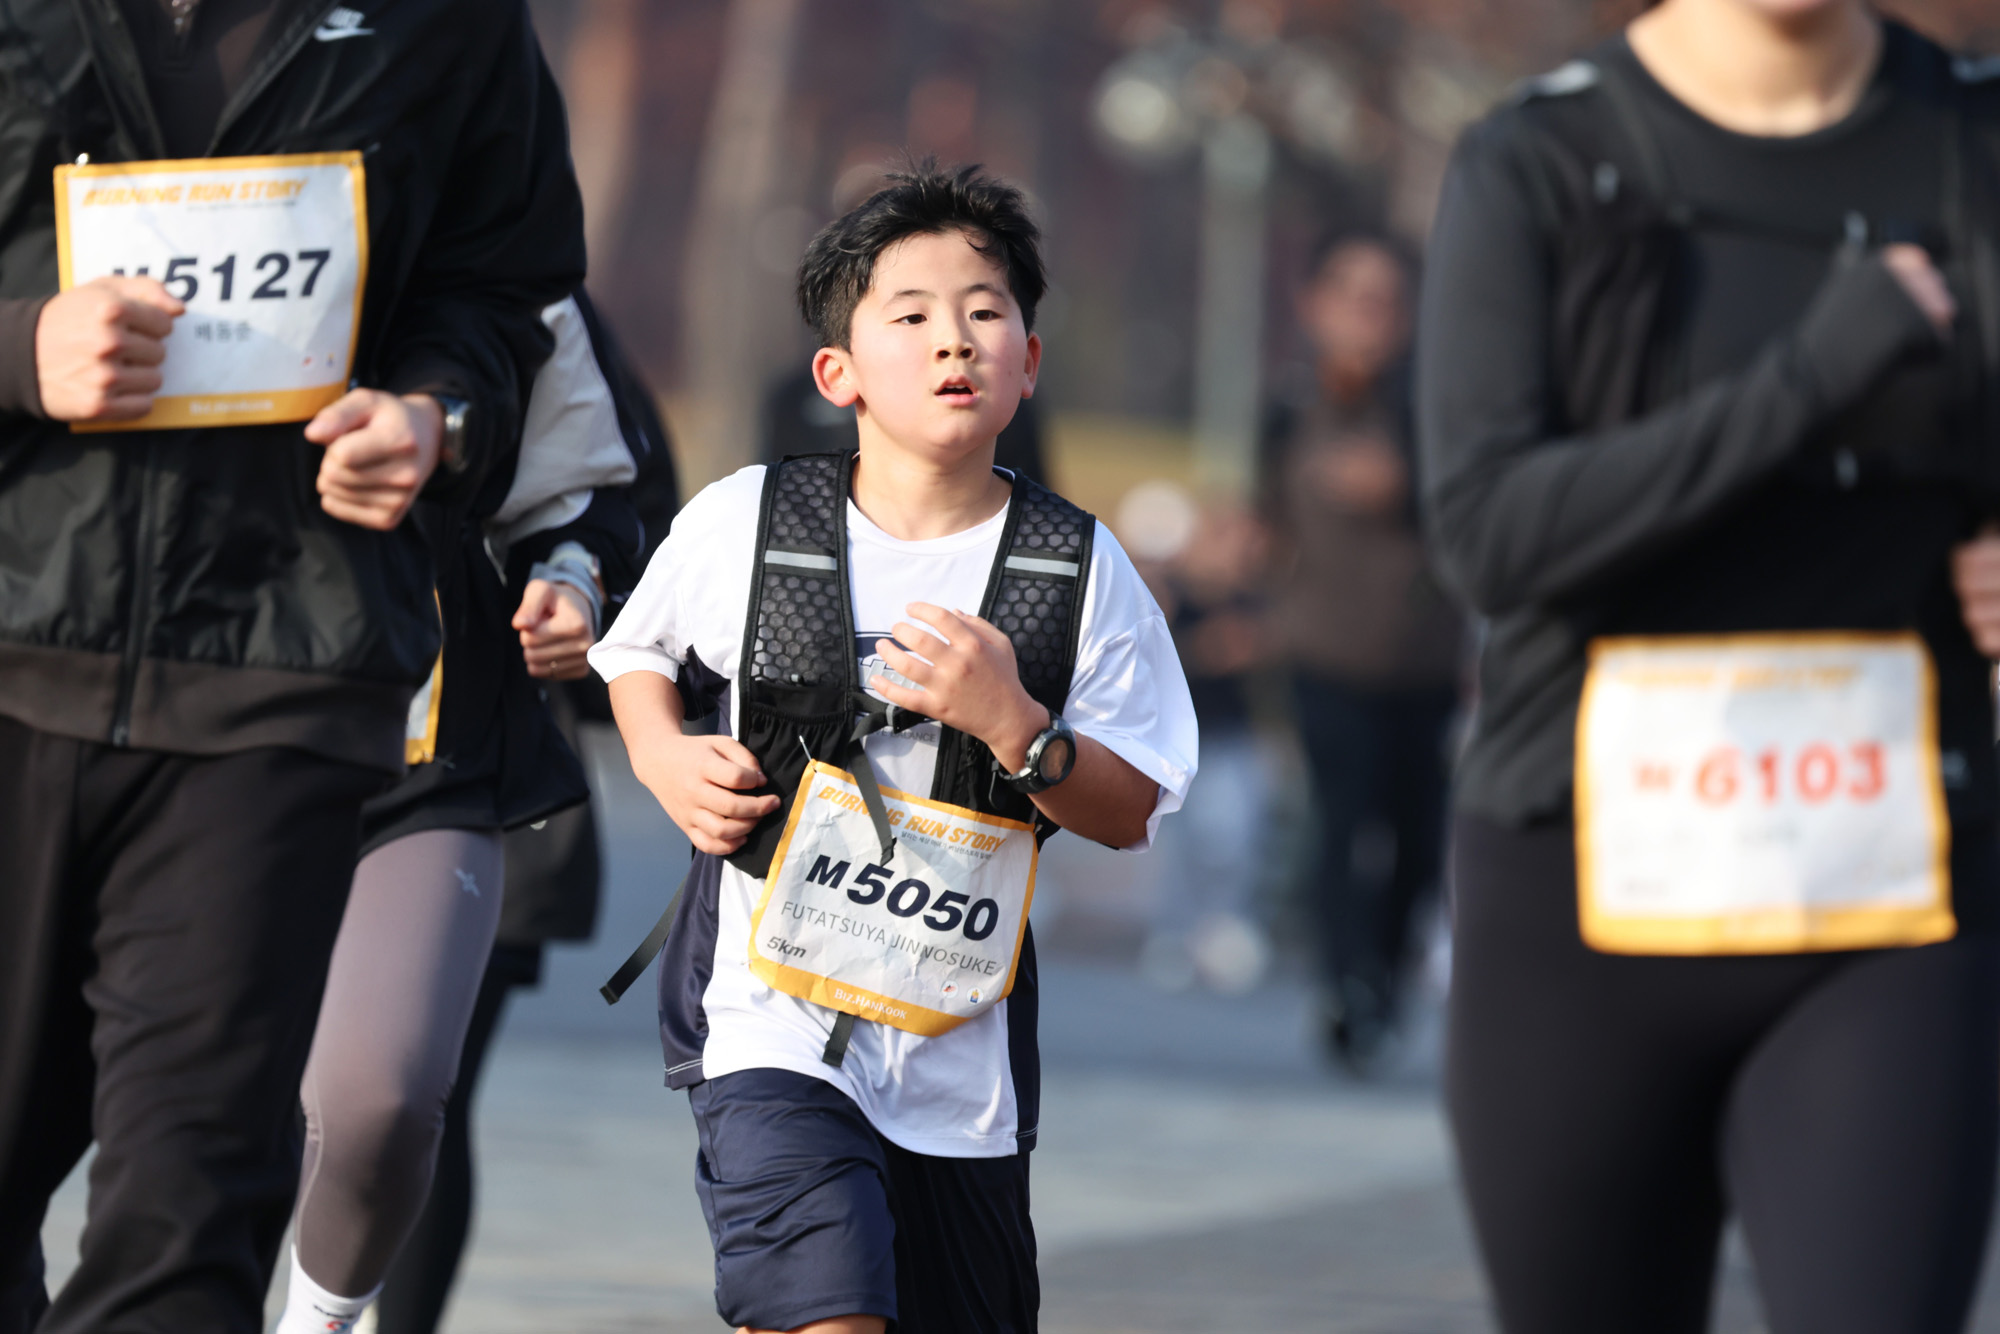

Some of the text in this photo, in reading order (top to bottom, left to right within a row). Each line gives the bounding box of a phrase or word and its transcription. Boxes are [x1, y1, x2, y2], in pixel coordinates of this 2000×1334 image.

[186, 180, 236, 204] RUN
[817, 785, 1007, 853] BURNG RUN STORY
[767, 936, 807, 958] 5km
[781, 901, 997, 976] FUTATSUYA JINNOSUKE
